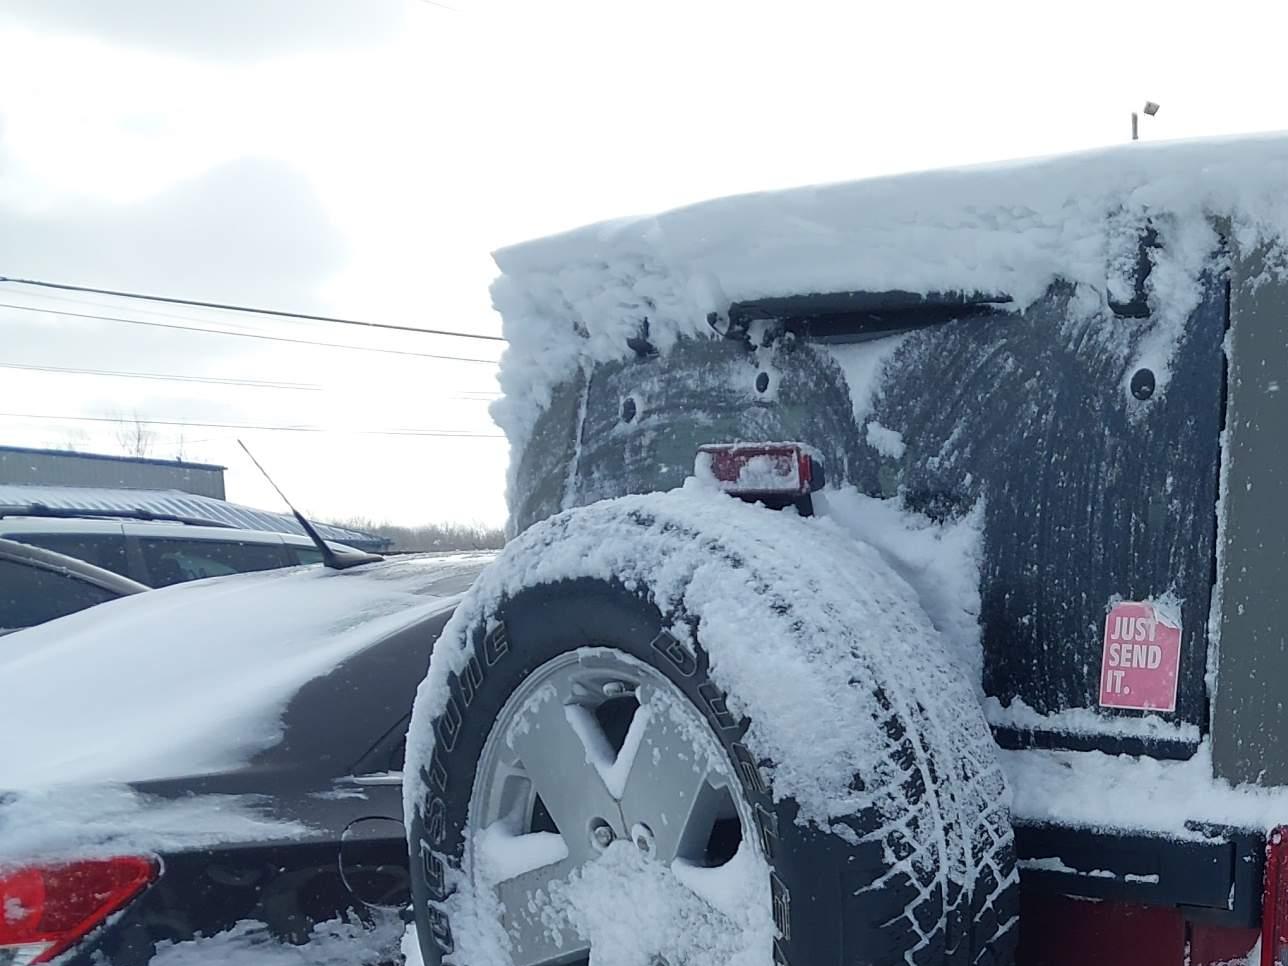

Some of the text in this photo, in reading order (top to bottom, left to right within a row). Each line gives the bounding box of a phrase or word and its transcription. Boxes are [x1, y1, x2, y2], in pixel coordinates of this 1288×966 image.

[1110, 616, 1157, 642] JUST
[1108, 643, 1162, 669] SEND
[1106, 670, 1130, 694] IT.
